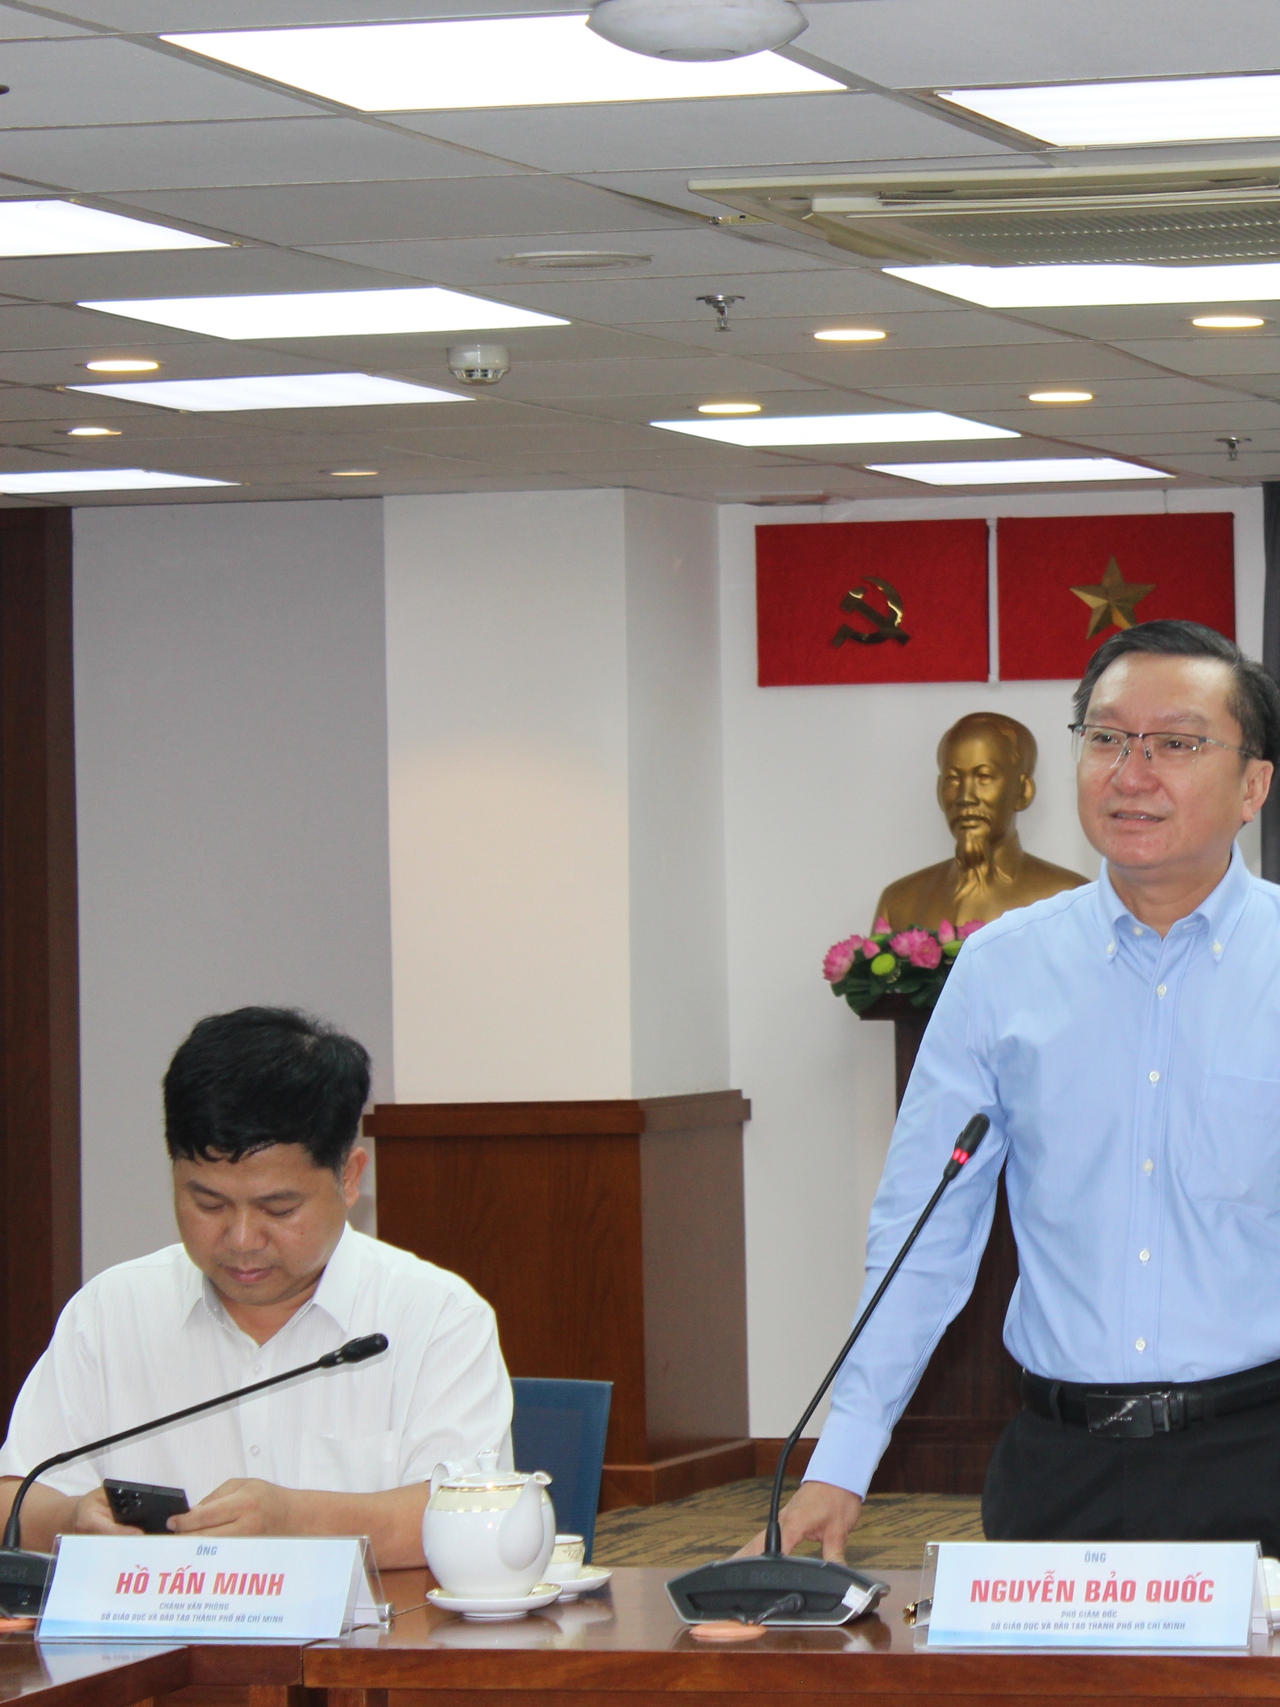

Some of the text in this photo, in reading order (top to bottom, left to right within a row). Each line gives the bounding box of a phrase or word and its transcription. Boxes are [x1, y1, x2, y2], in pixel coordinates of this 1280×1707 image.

[196, 1544, 218, 1556] ÔNG
[1084, 1551, 1106, 1563] ÔNG
[115, 1564, 285, 1597] HỒ TẤN MINH
[970, 1570, 1215, 1604] NGUYỄN BẢO QUỐC
[159, 1601, 185, 1610] CHÁNH
[112, 1611, 130, 1621] GIÁO
[131, 1613, 146, 1622] DỤC
[149, 1612, 157, 1621] VÀ
[220, 1612, 234, 1622] PHỐ
[247, 1613, 261, 1623] CHÍ
[262, 1615, 283, 1623] MINH
[1061, 1610, 1076, 1619] PHÓ
[1079, 1610, 1099, 1619] GIÁM
[1003, 1620, 1021, 1631] GIÁO
[1023, 1622, 1039, 1631] DỤC
[1041, 1621, 1051, 1631] VÀ
[1117, 1620, 1132, 1630] PHỐ
[1147, 1620, 1161, 1630] CHÍ
[1162, 1622, 1186, 1630] MINH
